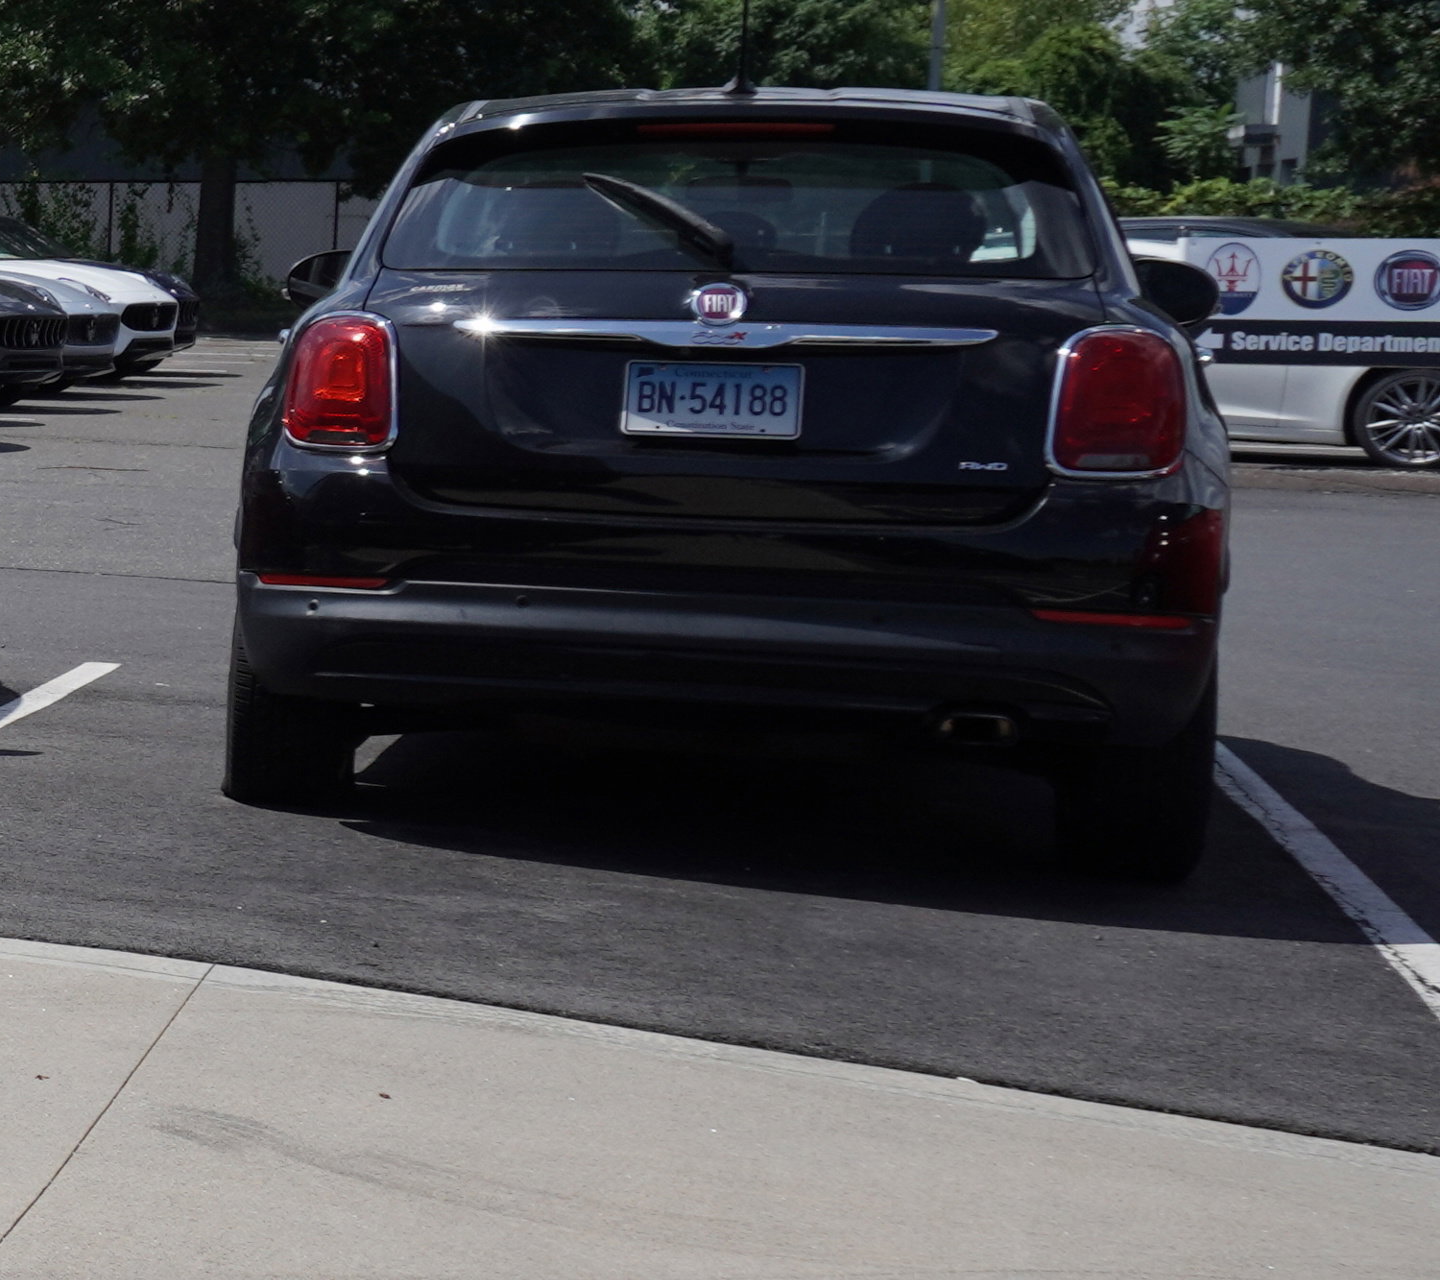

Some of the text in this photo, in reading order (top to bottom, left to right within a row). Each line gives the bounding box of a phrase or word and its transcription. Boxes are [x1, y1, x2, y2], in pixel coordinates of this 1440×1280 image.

[1391, 268, 1435, 294] FIAT
[703, 294, 736, 312] FIAT
[1232, 331, 1313, 351] Service
[675, 368, 752, 379] Connecticut
[666, 419, 756, 431] Constitution State
